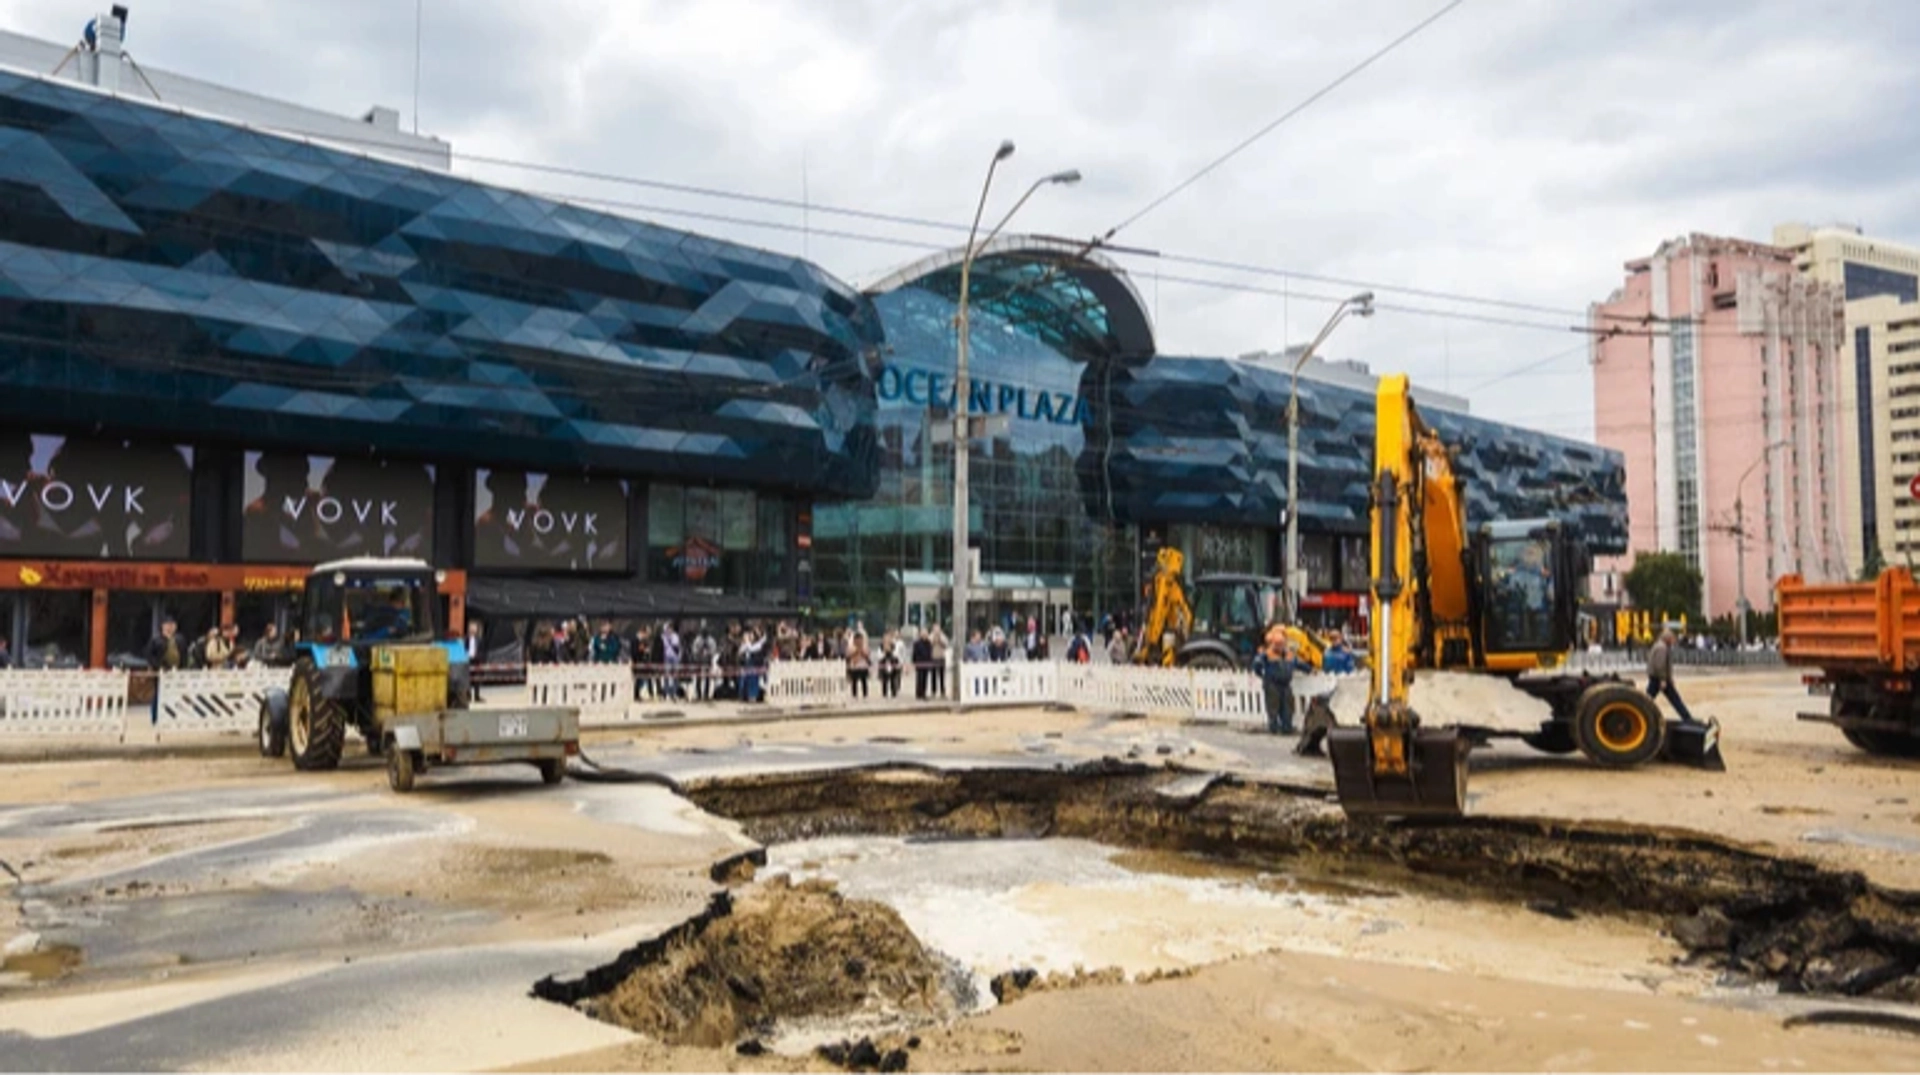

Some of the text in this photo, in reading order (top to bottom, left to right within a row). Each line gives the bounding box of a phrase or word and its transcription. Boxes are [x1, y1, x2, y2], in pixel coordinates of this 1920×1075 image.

[999, 383, 1094, 427] PLAZA
[1, 479, 144, 514] VOVK
[284, 495, 398, 525] VOVK
[508, 508, 598, 535] VOVK
